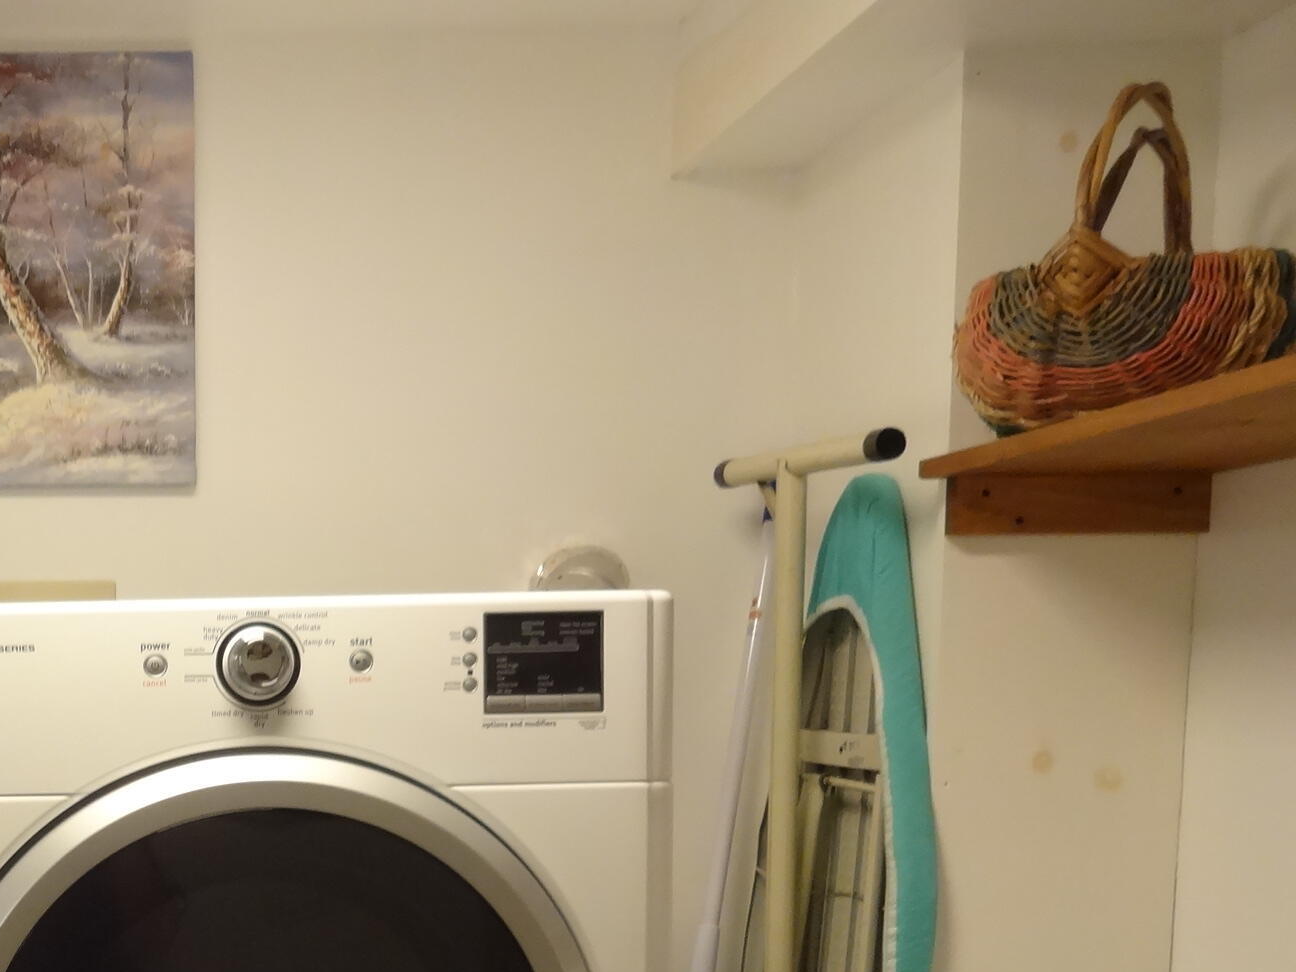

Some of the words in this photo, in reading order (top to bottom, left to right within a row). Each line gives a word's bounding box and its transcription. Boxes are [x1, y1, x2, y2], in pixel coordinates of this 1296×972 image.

[203, 627, 223, 635] heavy
[294, 624, 321, 632] delicate
[303, 639, 322, 648] damp
[323, 638, 336, 647] dry
[350, 637, 373, 647] start
[140, 642, 171, 652] power
[142, 679, 167, 688] cancel
[349, 675, 372, 684] pause
[211, 710, 231, 718] timed
[233, 710, 245, 719] dry
[277, 708, 304, 716] freshen
[305, 709, 314, 717] up
[254, 720, 265, 729] dry
[482, 719, 507, 728] options
[510, 719, 523, 727] and
[524, 717, 557, 727] modifiers
